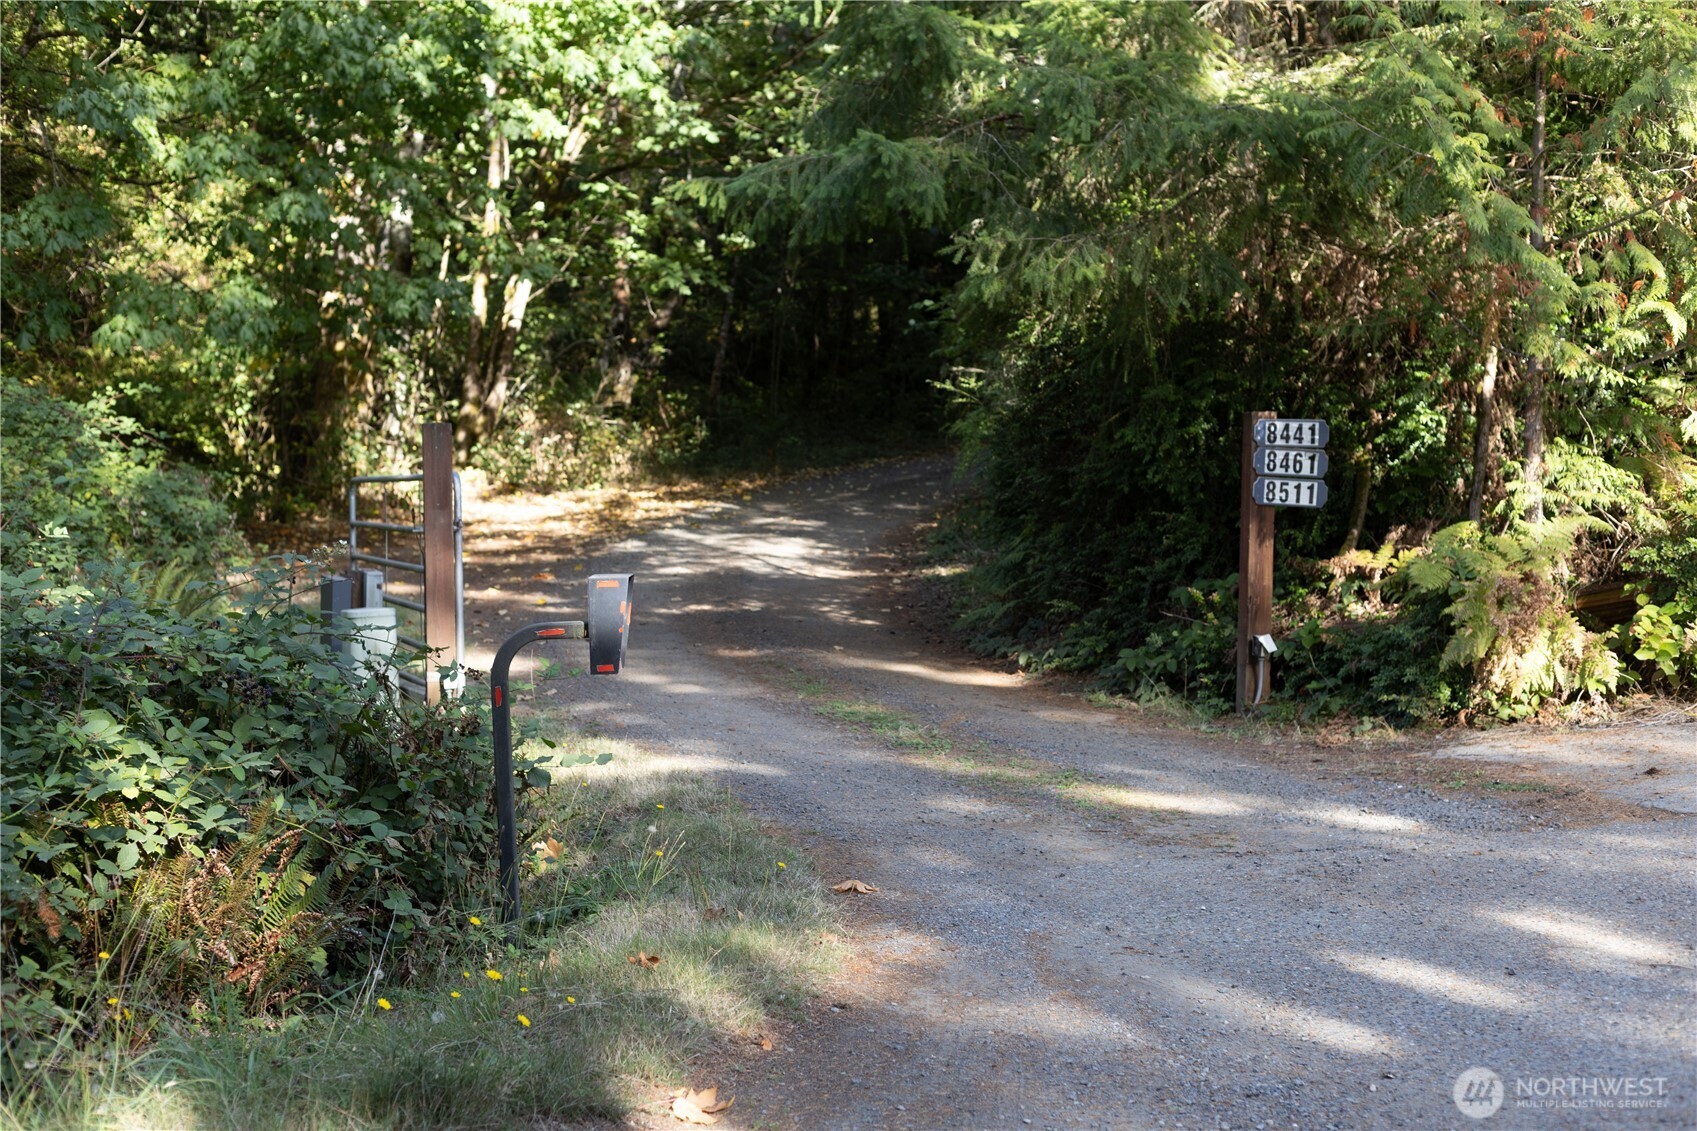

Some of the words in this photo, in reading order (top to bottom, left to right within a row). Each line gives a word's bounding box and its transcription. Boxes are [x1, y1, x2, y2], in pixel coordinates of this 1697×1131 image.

[1267, 422, 1316, 444] 8441
[1266, 451, 1316, 474] 8461
[1265, 481, 1315, 504] 8511
